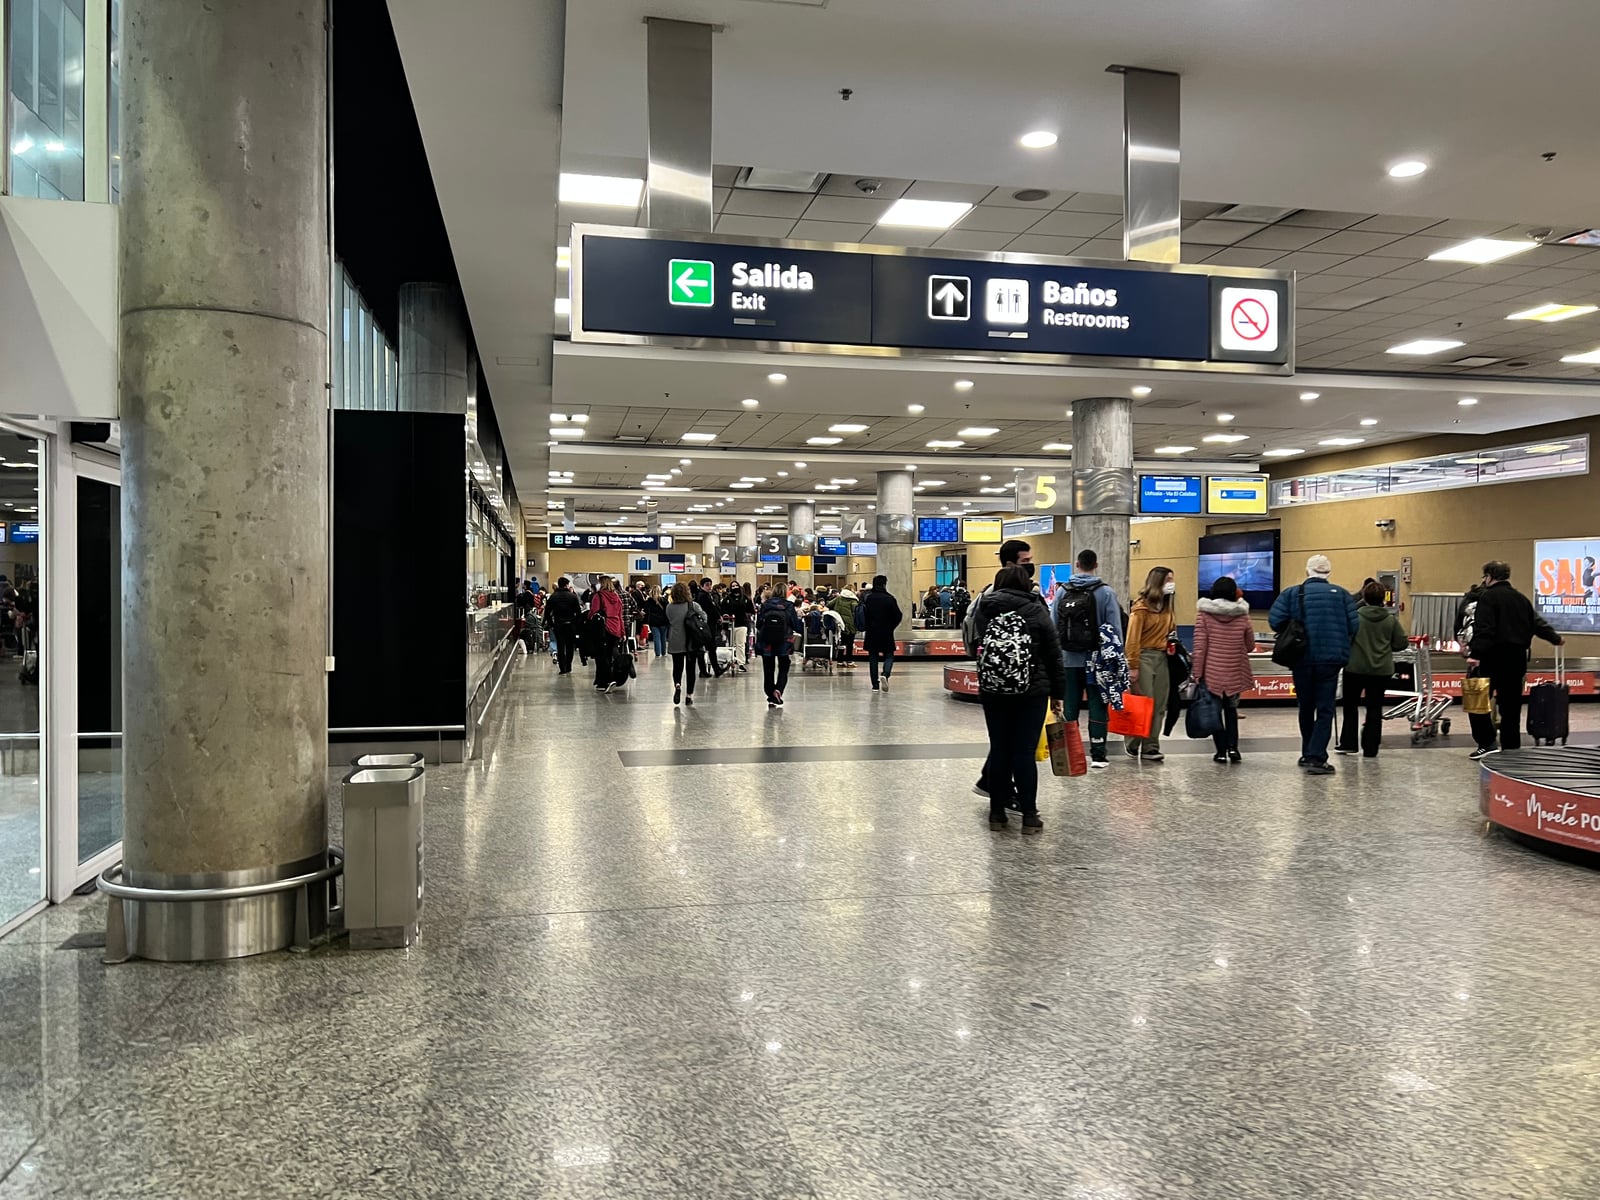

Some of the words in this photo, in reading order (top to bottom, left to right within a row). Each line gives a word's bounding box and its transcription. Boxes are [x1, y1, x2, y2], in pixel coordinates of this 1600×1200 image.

[732, 262, 814, 290] Salida
[732, 291, 766, 310] Exit
[1043, 280, 1117, 307] Baños
[1043, 308, 1130, 329] Restrooms
[1034, 475, 1057, 509] 5
[852, 518, 867, 539] 4
[720, 549, 730, 561] 2
[769, 538, 780, 552] 3
[1539, 559, 1585, 595] SAL
[1441, 680, 1450, 688] LA
[1566, 679, 1584, 687] RIOJA
[1581, 812, 1600, 832] PO
